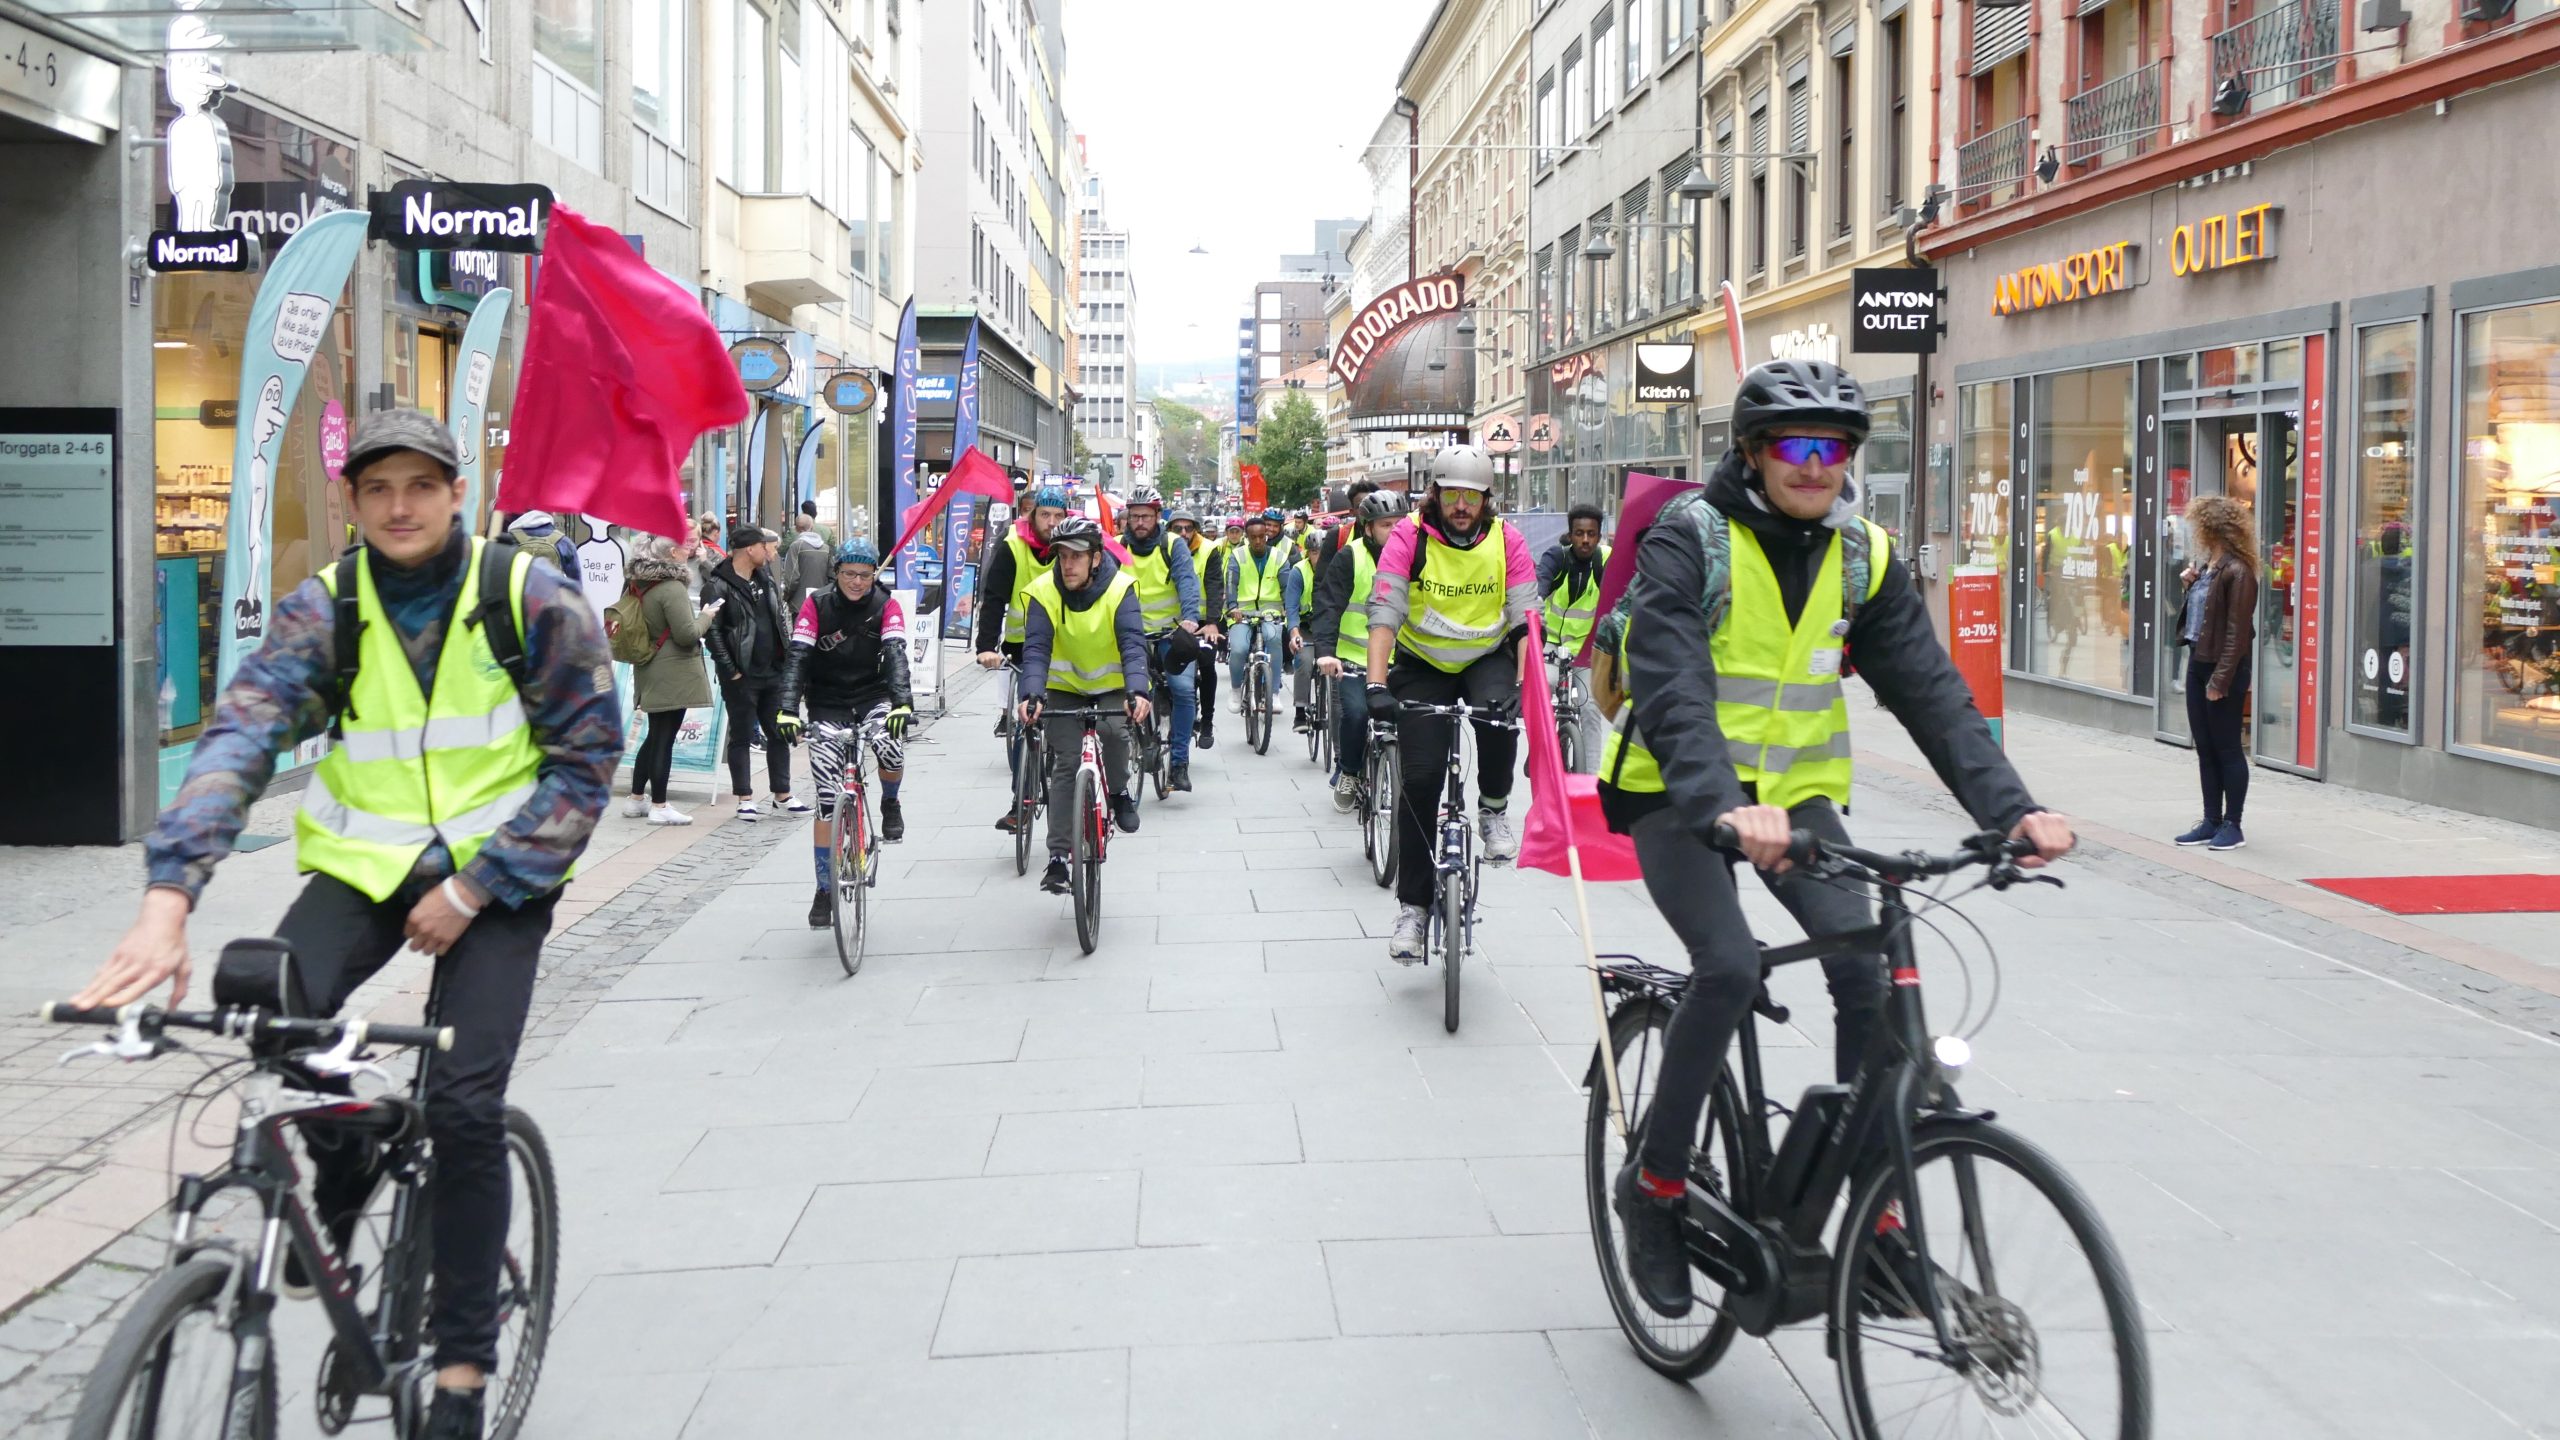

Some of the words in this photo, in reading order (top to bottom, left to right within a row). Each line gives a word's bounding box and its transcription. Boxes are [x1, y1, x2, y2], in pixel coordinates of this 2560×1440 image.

[407, 191, 540, 237] Normal
[157, 236, 239, 264] Normal
[2170, 202, 2272, 277] OUTLET
[455, 249, 498, 281] Normal
[1858, 291, 1934, 308] ANTON
[1336, 279, 1459, 383] ELDORADO
[1863, 314, 1930, 330] OUTLET
[915, 390, 952, 399] ompany
[0, 441, 60, 458] Torggata
[65, 441, 105, 455] 2-4-6
[1970, 493, 1998, 536] 70%
[2063, 492, 2100, 541] 70%
[583, 558, 601, 573] Jeg
[605, 561, 616, 571] er
[588, 573, 609, 584] Unik
[680, 728, 703, 741] 78,-
